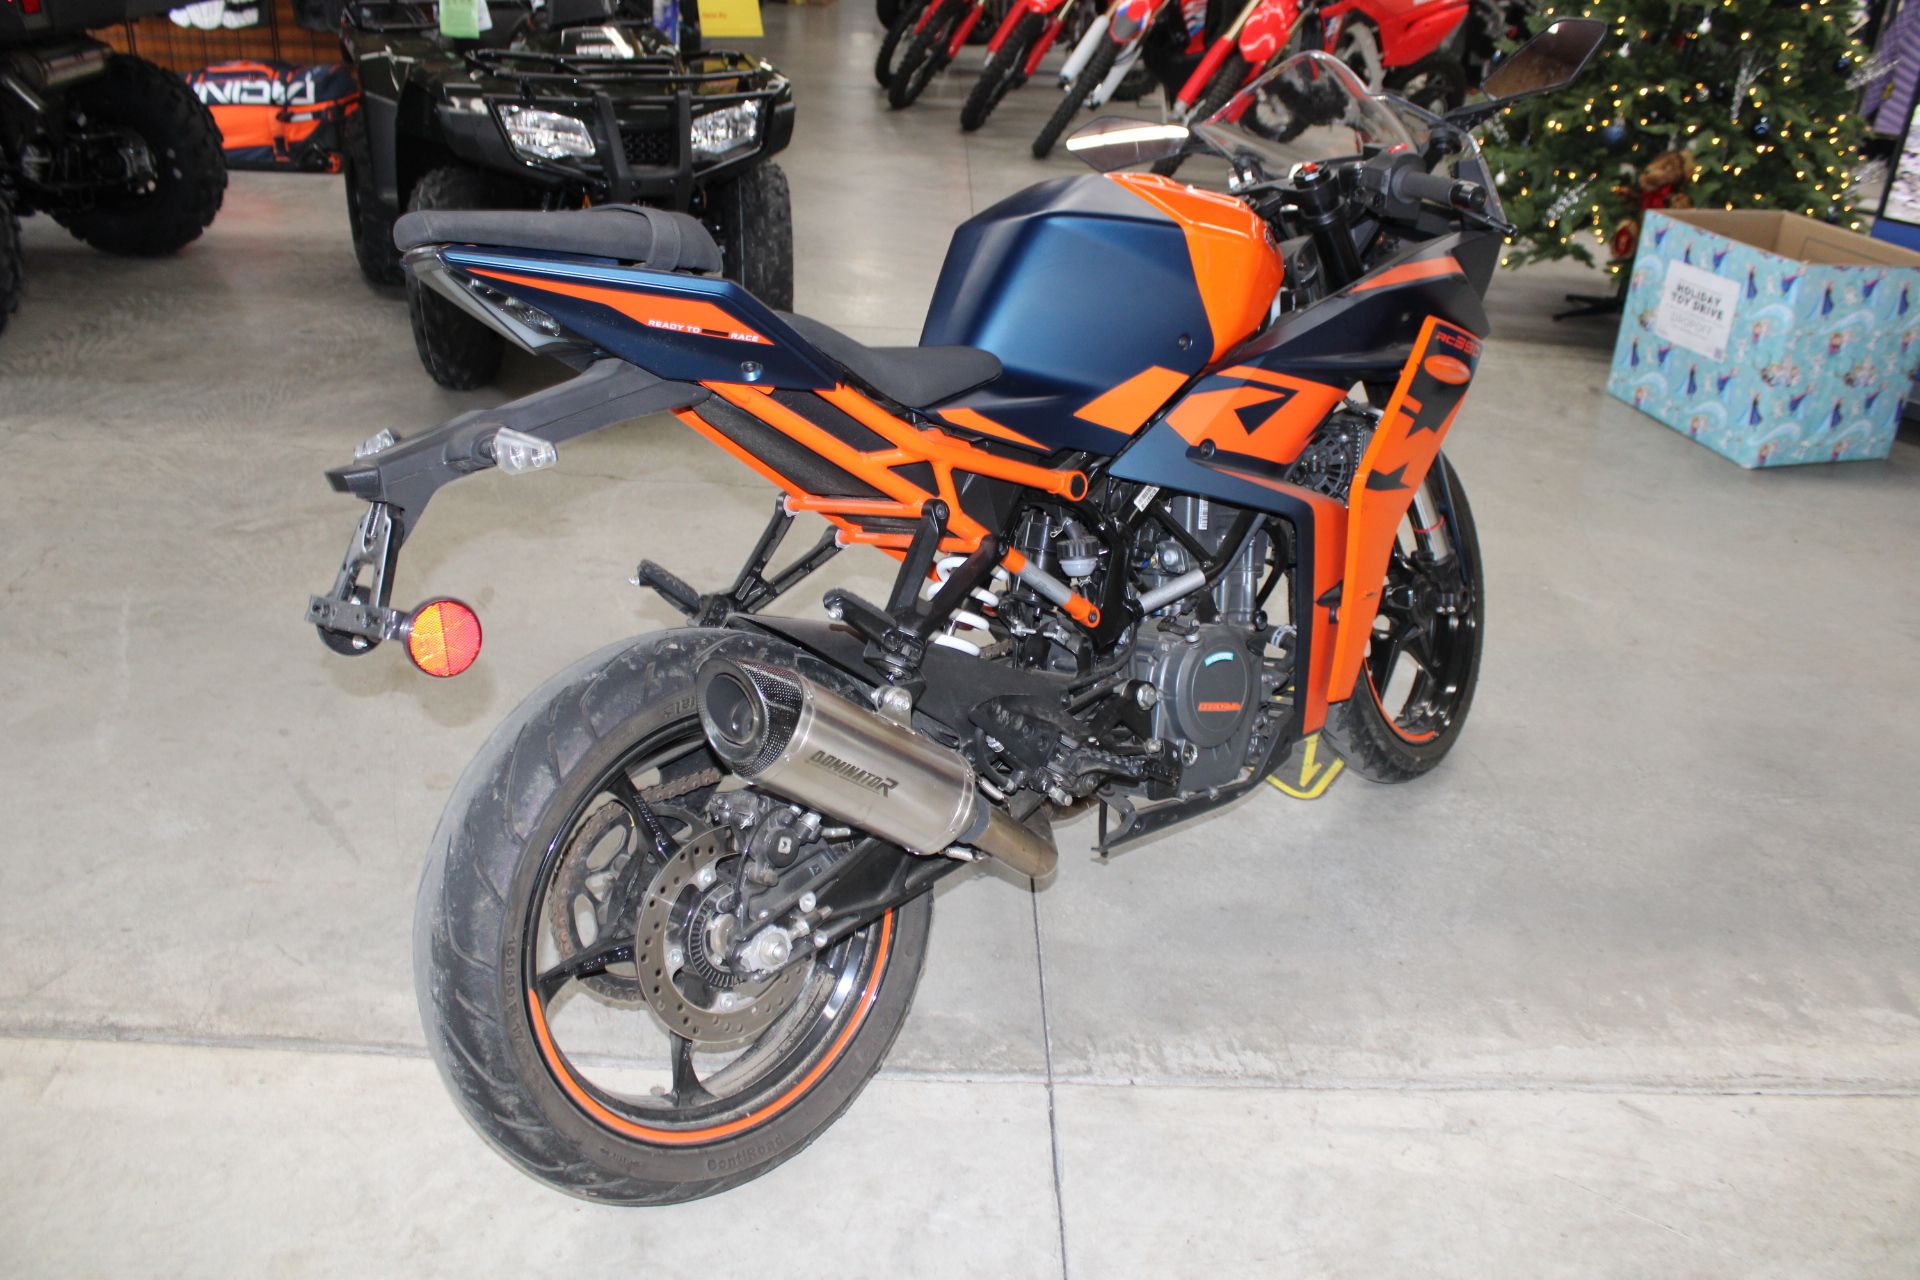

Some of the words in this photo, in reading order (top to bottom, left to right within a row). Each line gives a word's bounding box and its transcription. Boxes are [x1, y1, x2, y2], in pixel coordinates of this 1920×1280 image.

[1672, 292, 1692, 306] TOY
[1693, 302, 1723, 320] DRIVE
[1677, 284, 1722, 306] HOLIDAY
[648, 320, 685, 331] READY
[686, 325, 701, 334] TO
[731, 332, 759, 342] RACE
[1435, 332, 1480, 358] RC390
[810, 750, 899, 797] DOMINATOR
[706, 1134, 784, 1172] ContiRoad
